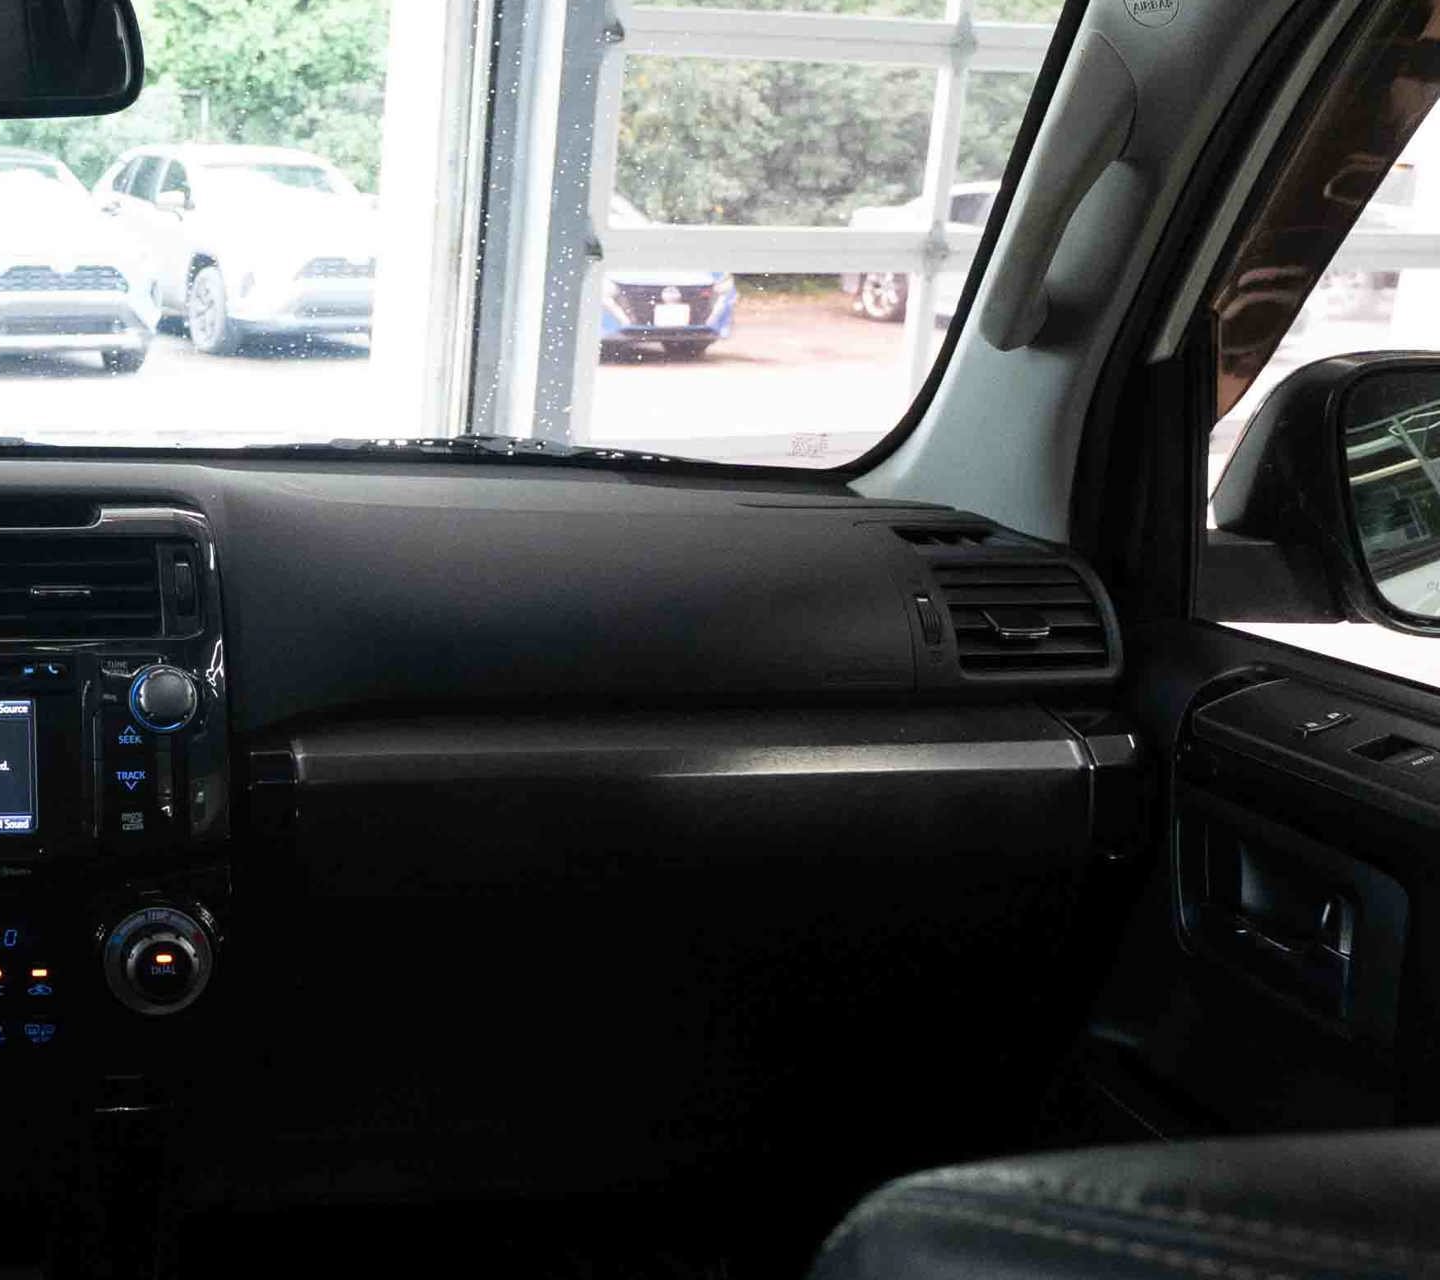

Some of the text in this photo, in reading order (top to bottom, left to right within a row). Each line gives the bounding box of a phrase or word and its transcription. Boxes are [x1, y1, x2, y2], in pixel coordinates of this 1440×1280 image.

[118, 735, 143, 745] SEEK
[115, 770, 146, 780] TRACK
[4, 819, 29, 830] Sound
